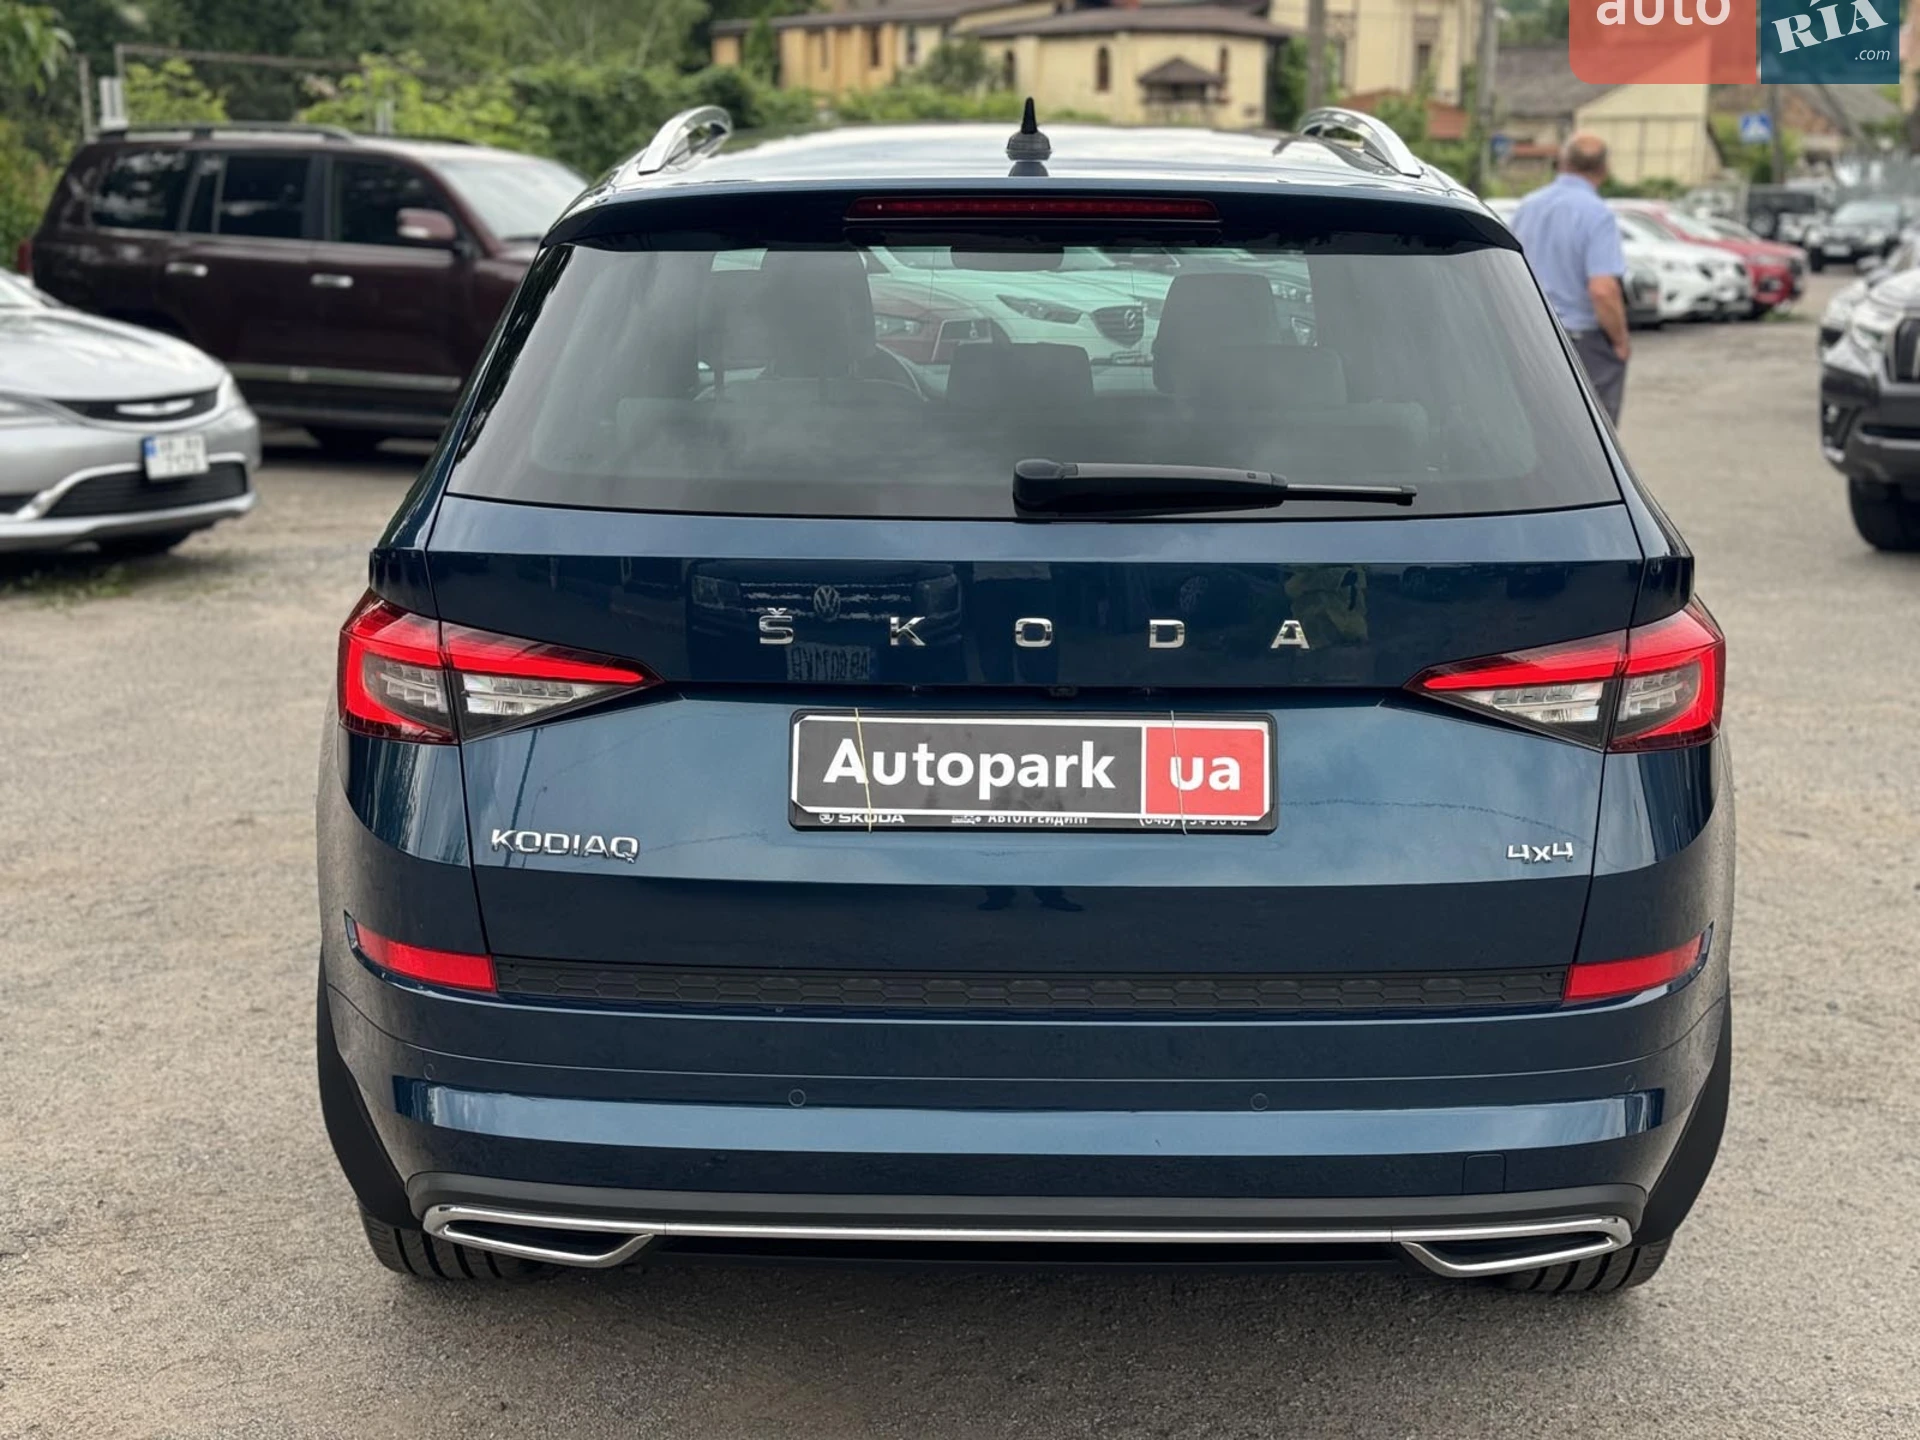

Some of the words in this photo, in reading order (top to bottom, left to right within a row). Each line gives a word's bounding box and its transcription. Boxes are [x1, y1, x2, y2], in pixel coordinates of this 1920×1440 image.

[758, 607, 1310, 650] ŠKODA
[823, 738, 1116, 800] Autopark
[1169, 755, 1241, 791] ua
[491, 829, 639, 863] KODIAQ
[1507, 842, 1574, 863] 4x4
